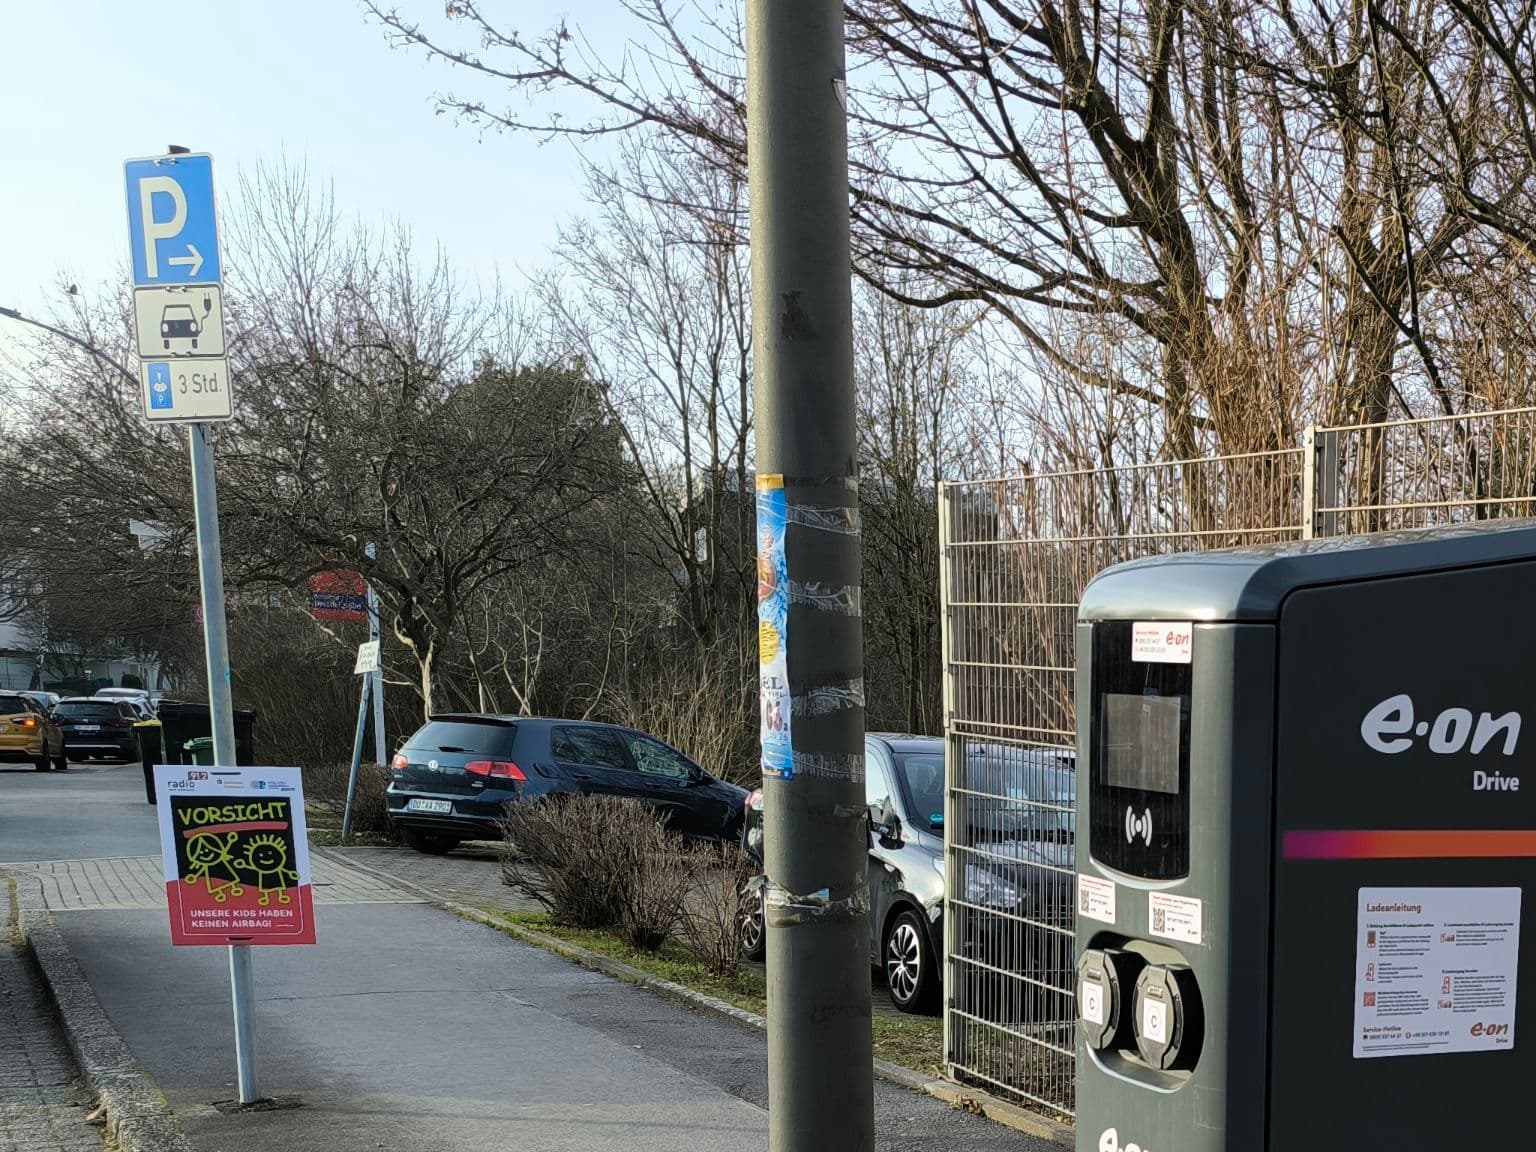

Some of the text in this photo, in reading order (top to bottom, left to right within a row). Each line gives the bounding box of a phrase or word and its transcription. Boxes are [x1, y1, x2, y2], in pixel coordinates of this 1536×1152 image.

[140, 176, 188, 279] P
[178, 372, 222, 394] 3 Std.
[167, 779, 195, 788] radio
[1473, 770, 1520, 791] Drive
[178, 802, 287, 825] VORSICHT
[190, 909, 293, 917] UNSERE KIDS HABEN
[1366, 904, 1422, 914] Ladeanleitung
[191, 920, 272, 928] KEINEN AIRBAG!
